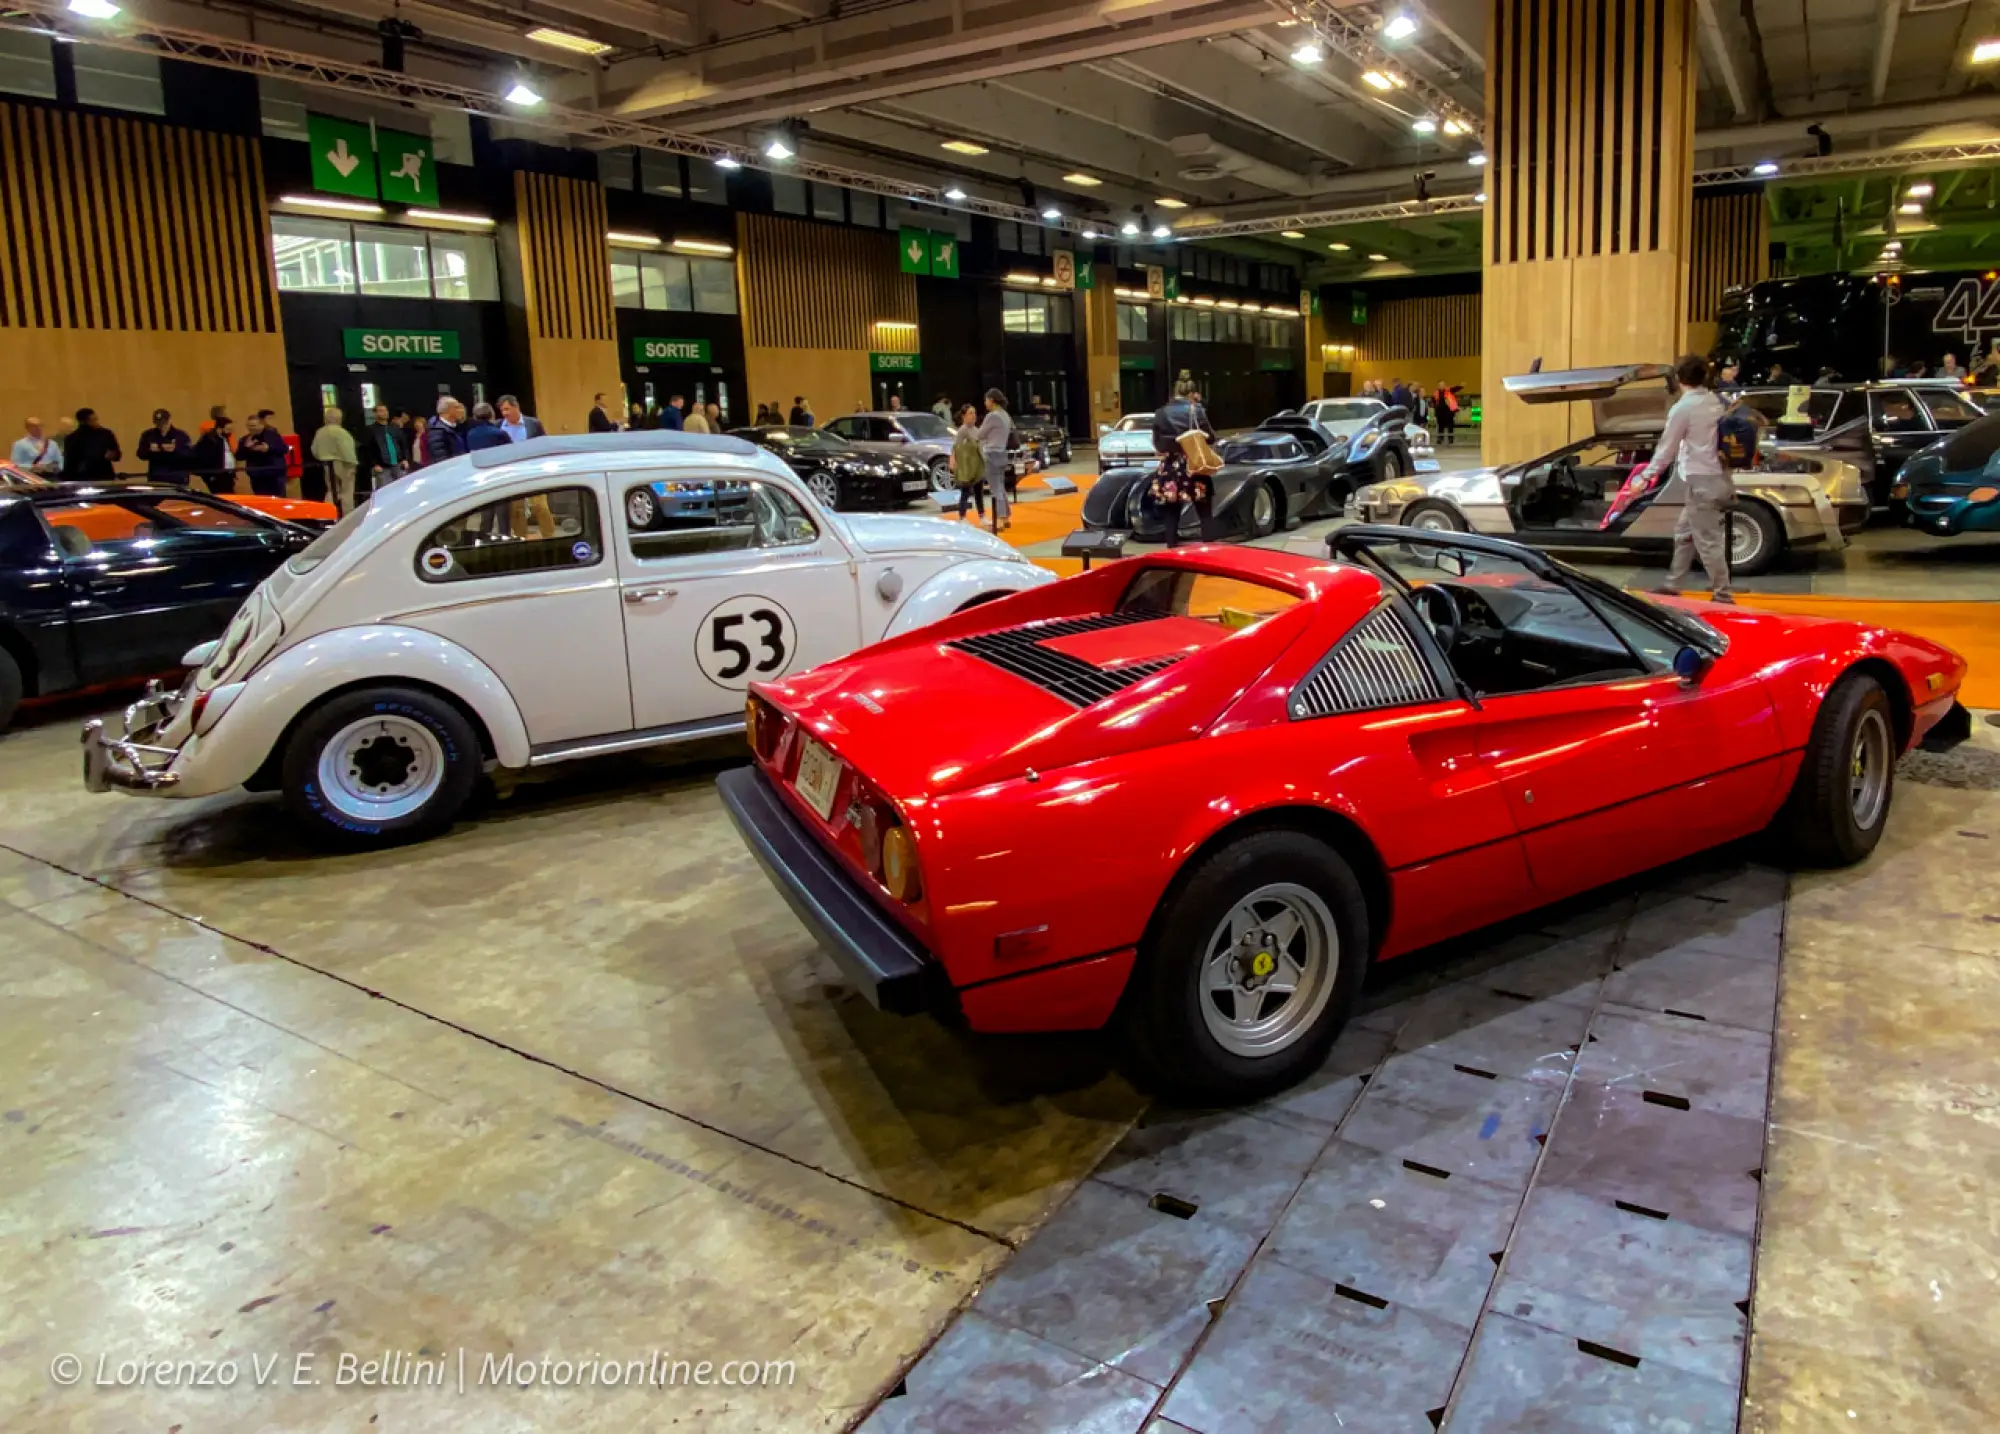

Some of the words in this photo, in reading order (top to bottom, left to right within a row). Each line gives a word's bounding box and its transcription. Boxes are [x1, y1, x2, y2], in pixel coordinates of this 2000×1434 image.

[362, 334, 443, 353] SORTIE
[645, 342, 700, 358] SORTIE
[878, 355, 914, 368] SORTIE
[713, 608, 785, 678] 53
